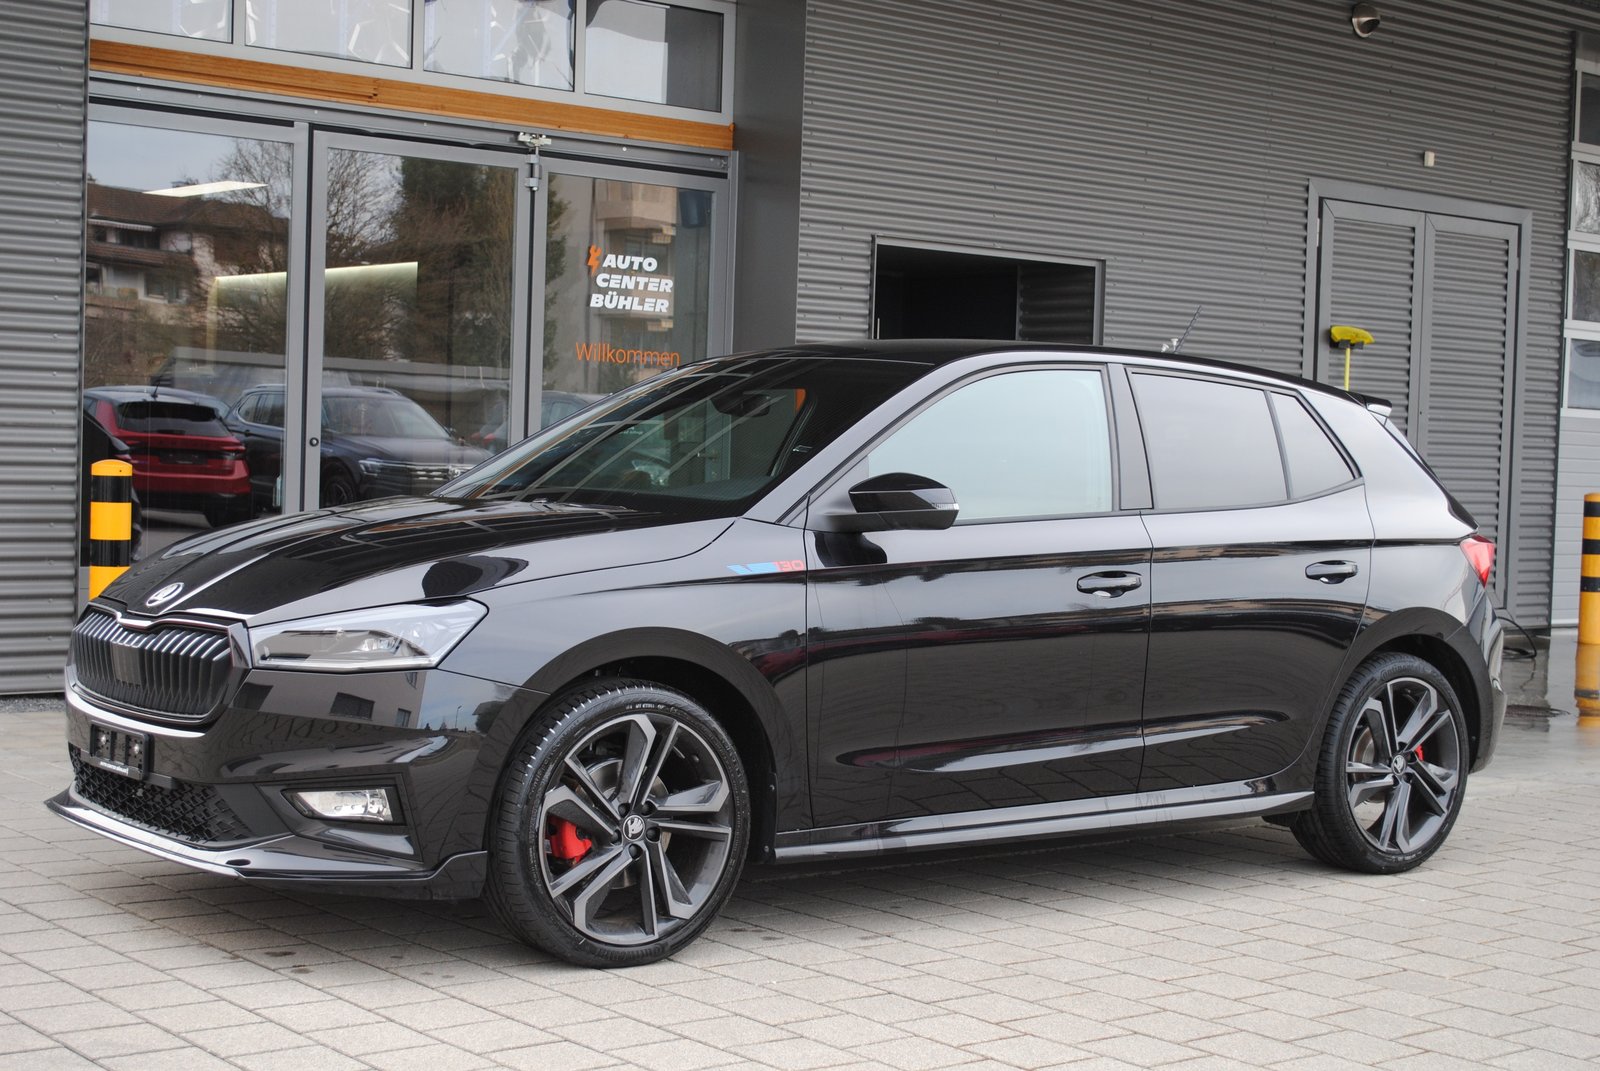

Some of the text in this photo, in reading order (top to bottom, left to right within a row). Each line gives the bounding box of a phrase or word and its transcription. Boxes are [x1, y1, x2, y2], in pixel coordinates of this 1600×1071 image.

[602, 254, 658, 272] AUTO
[596, 273, 674, 293] CENTER
[590, 291, 670, 313] BÜHLER
[575, 342, 680, 366] Willkommen
